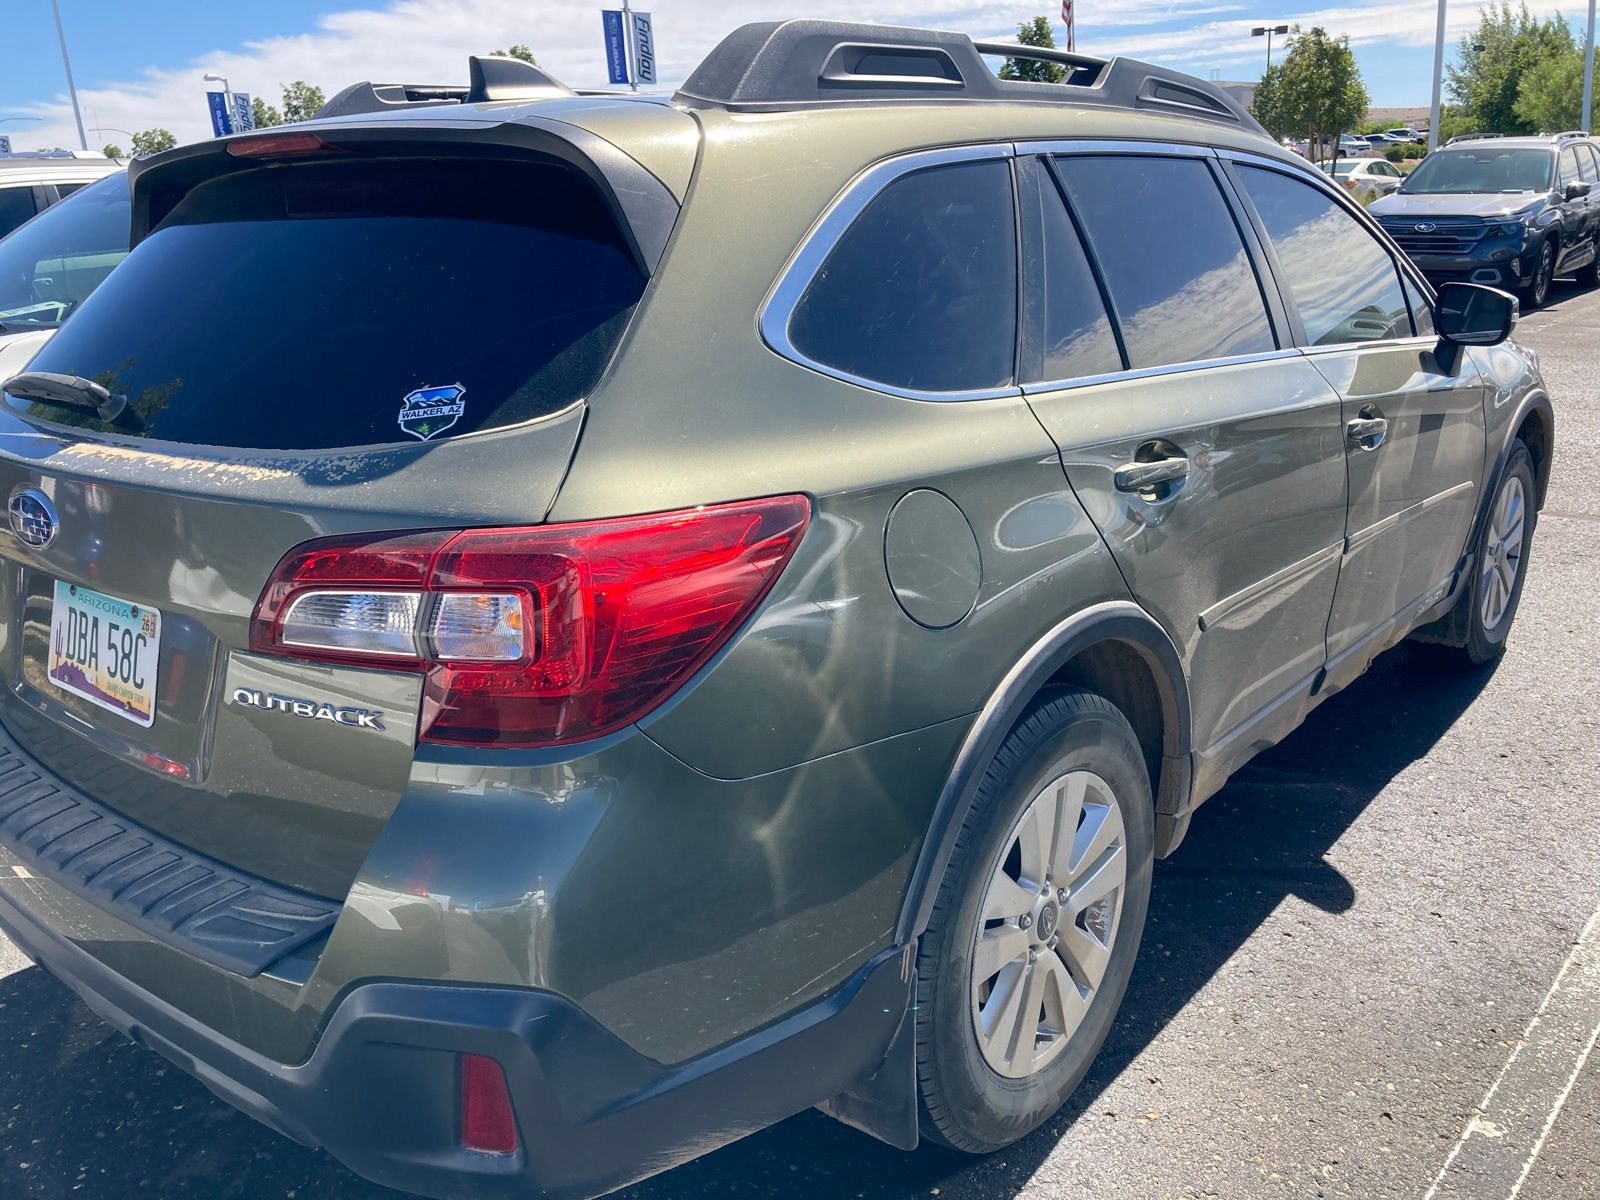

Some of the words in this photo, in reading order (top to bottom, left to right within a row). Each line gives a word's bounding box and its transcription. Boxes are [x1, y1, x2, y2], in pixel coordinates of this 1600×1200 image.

[611, 36, 622, 80] SUBARU
[637, 16, 653, 81] Findlay
[402, 408, 445, 419] WALKER,
[448, 406, 461, 414] AZ
[78, 593, 129, 619] ARIZONA
[142, 618, 149, 631] 26
[66, 606, 98, 671] DBA
[107, 622, 146, 689] 58C
[233, 687, 386, 731] OUTBACK
